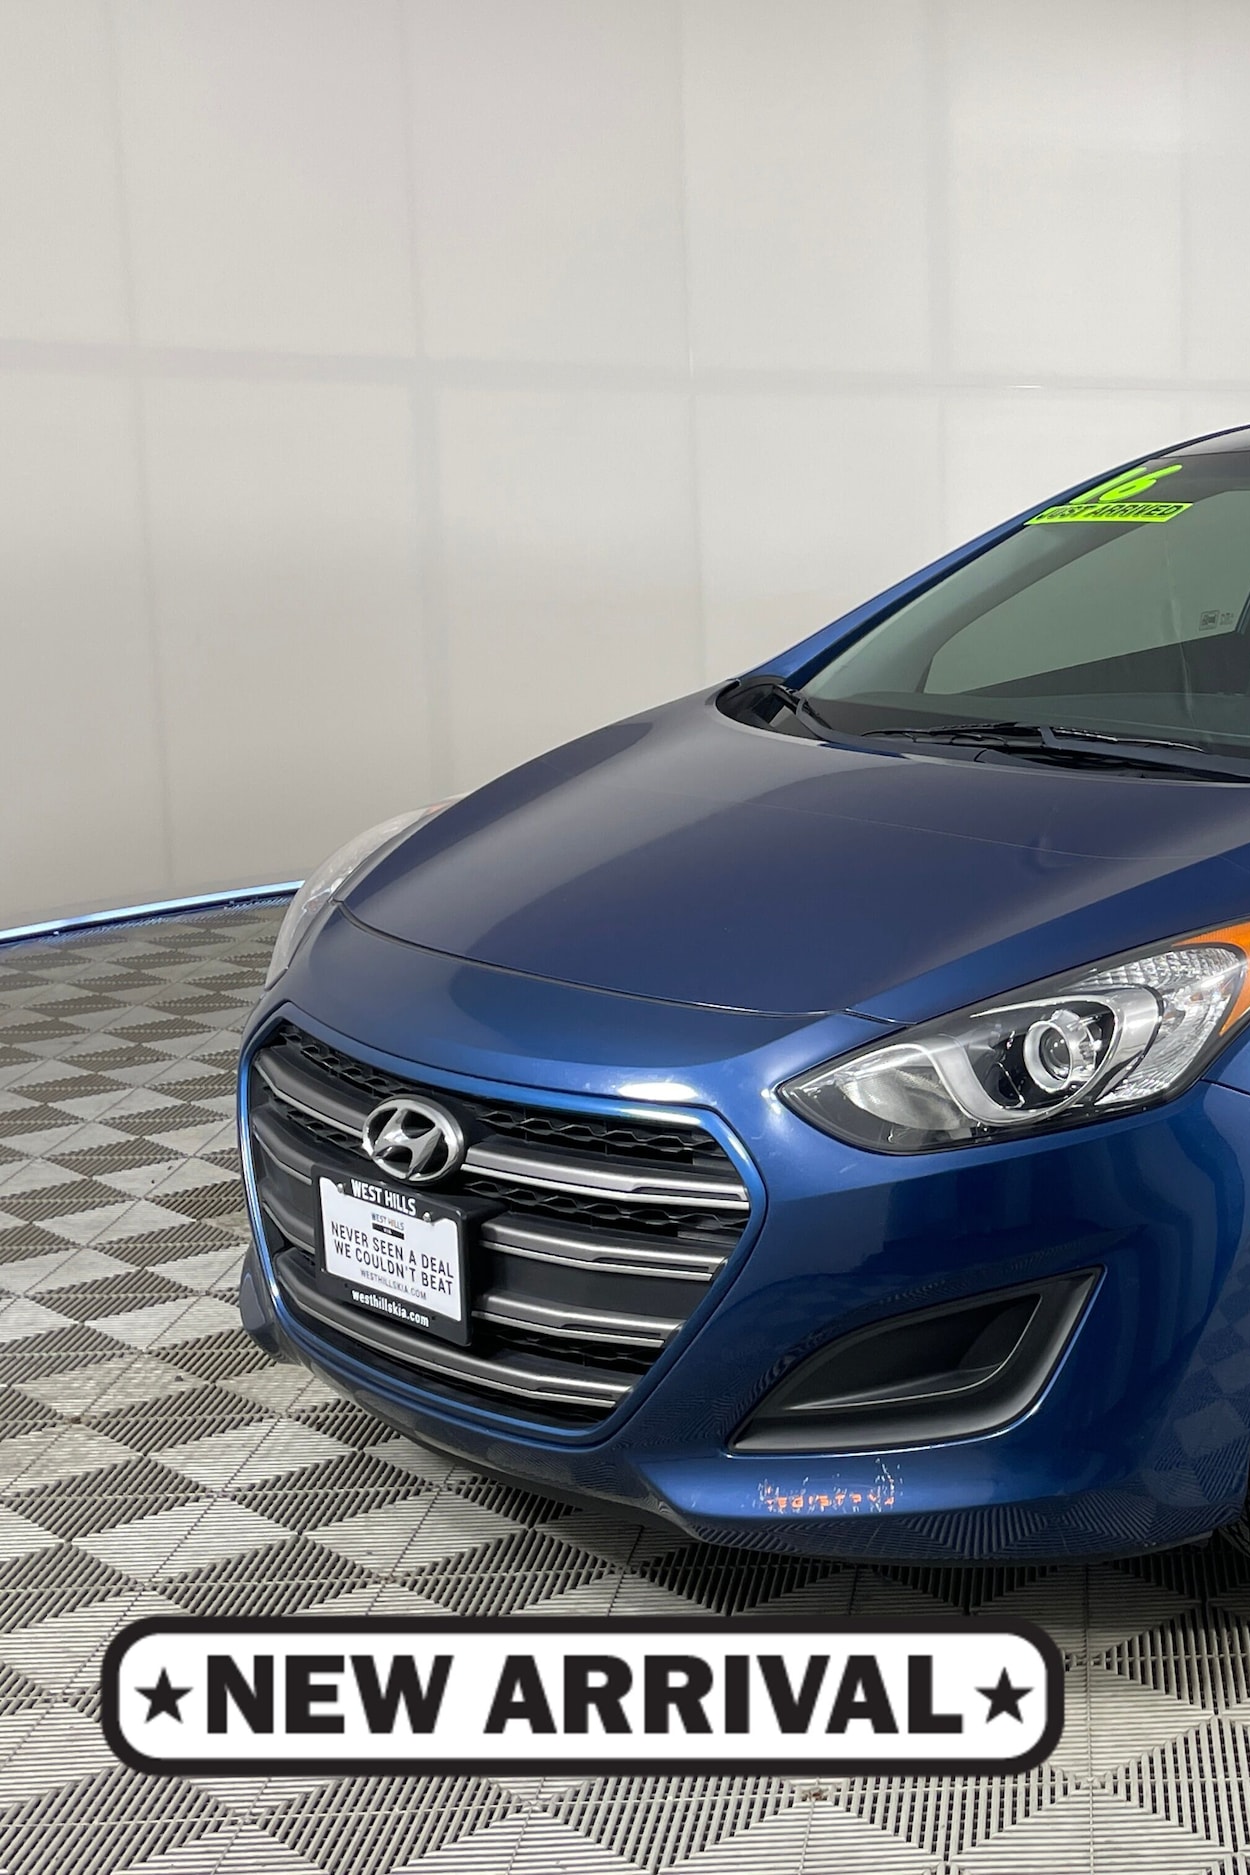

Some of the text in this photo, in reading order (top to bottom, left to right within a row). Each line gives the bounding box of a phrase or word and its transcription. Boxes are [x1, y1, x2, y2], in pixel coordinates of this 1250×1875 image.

[1088, 504, 1184, 518] ARRIVED
[351, 1179, 416, 1216] WEST HILLS
[331, 1221, 454, 1279] NEVER SEEN A DEAL
[334, 1240, 453, 1295] WE COULDN'T BEAT
[360, 1268, 427, 1300] WESTHILLSKIA.COM
[352, 1289, 429, 1328] westhillskia.com
